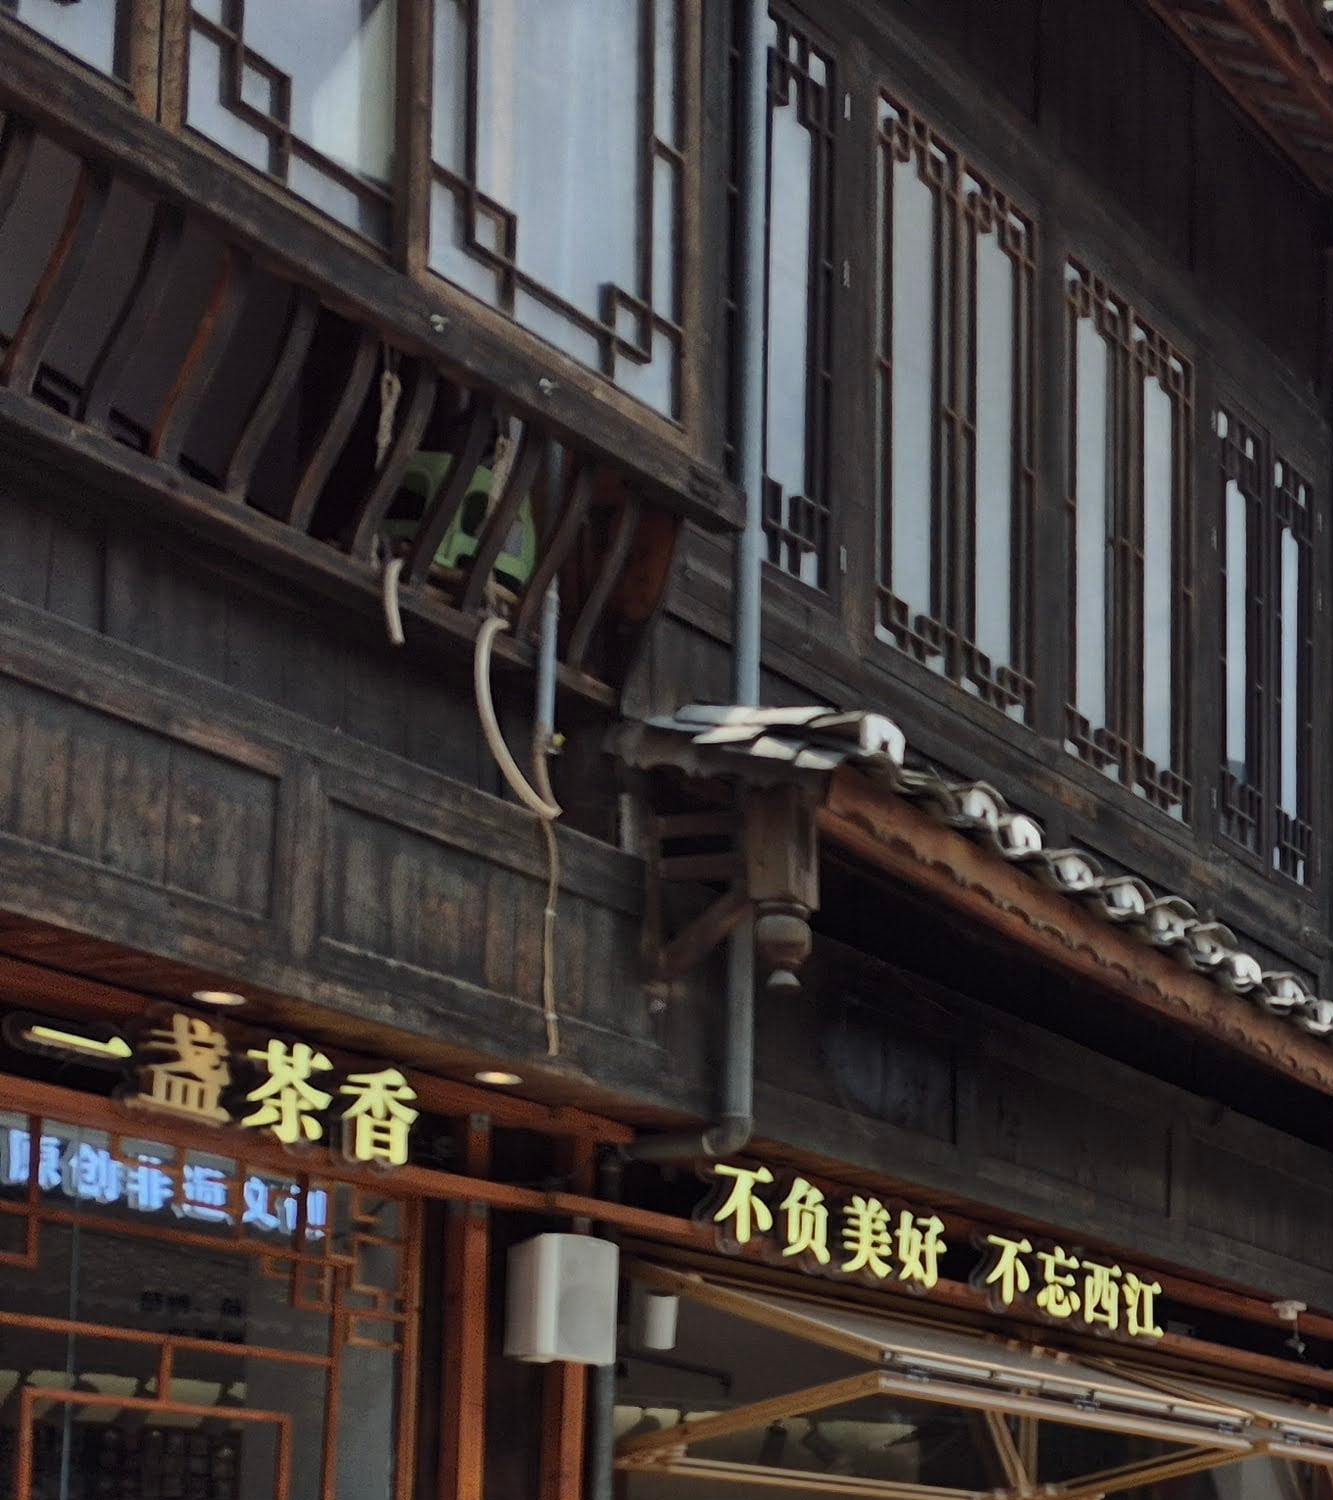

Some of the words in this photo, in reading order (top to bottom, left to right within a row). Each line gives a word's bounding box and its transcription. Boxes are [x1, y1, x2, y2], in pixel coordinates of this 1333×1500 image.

[22, 1012, 419, 1165] 一盏茶香
[713, 1163, 947, 1289] 不负美好
[986, 1233, 1164, 1337] 不忘西江
